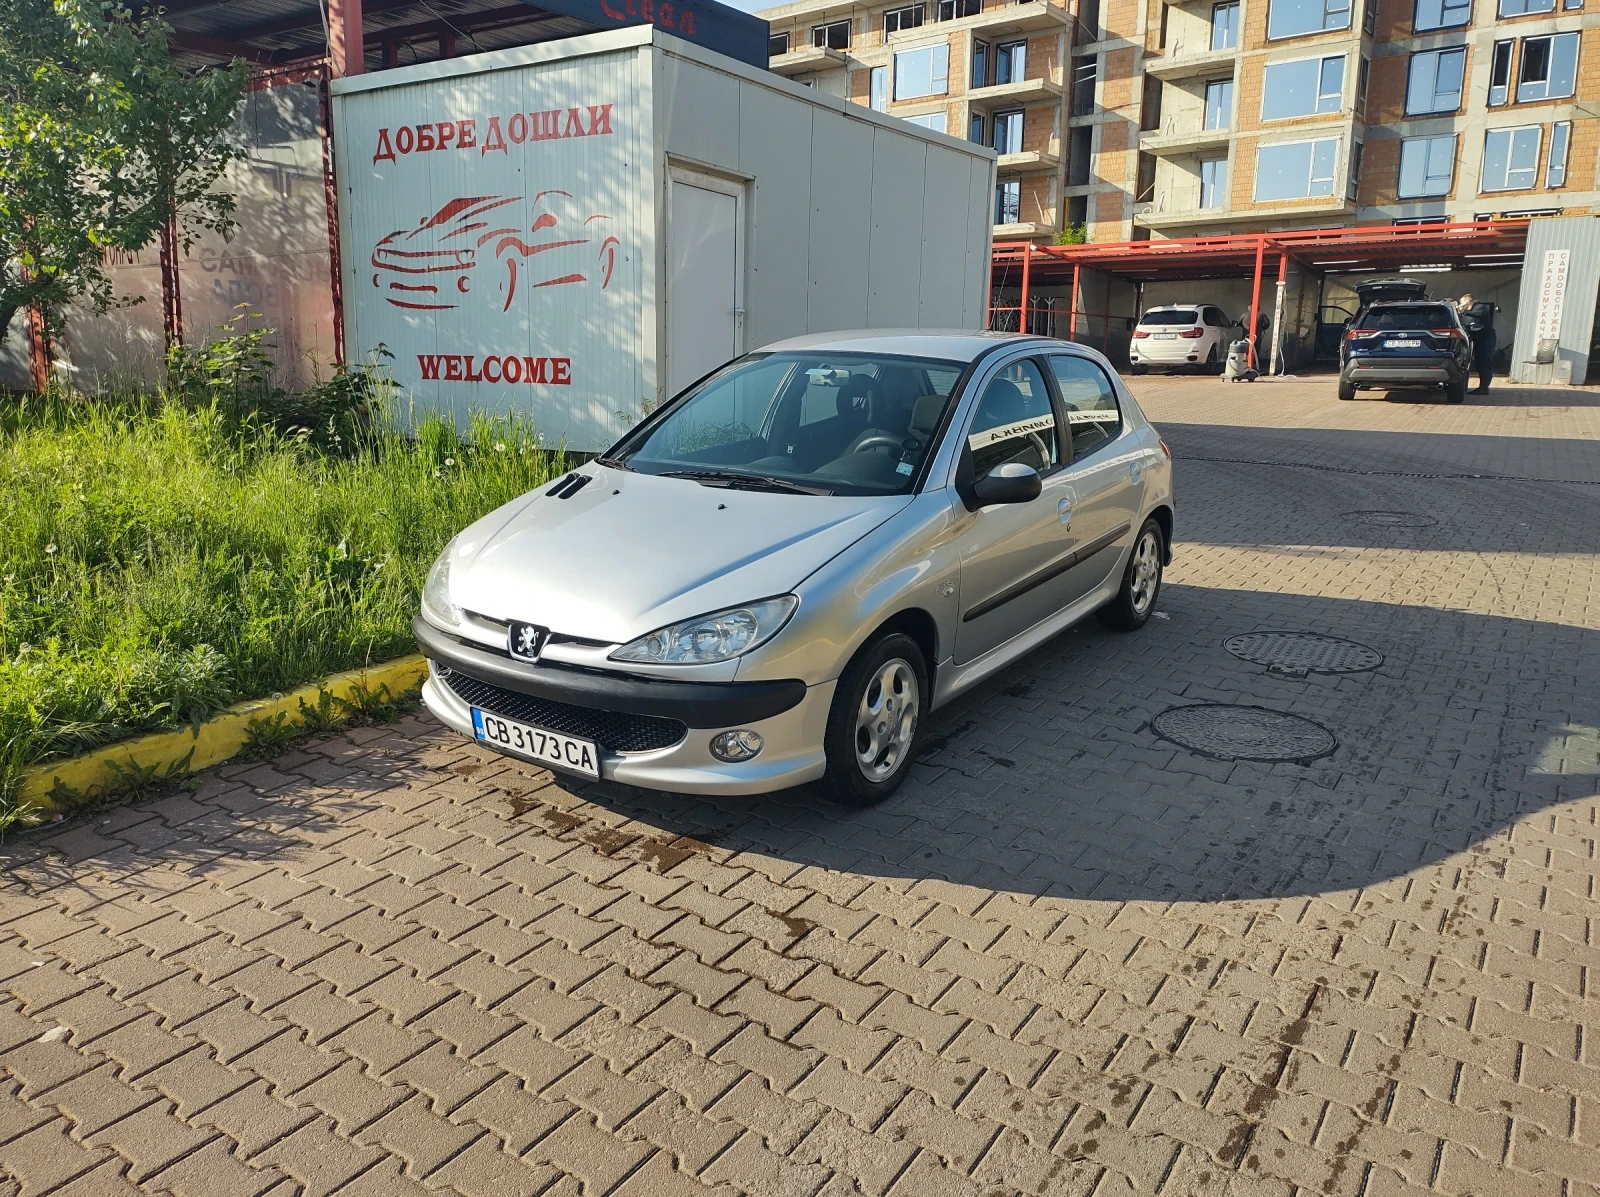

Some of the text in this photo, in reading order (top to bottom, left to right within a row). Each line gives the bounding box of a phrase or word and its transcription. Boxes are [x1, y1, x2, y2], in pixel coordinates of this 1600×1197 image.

[373, 103, 614, 167] ДОБРЕ ДОШЛИ
[1550, 253, 1567, 339] САМООБСЛУЖВА
[416, 354, 571, 385] WELCOME
[485, 716, 595, 771] CB 3173 CA
